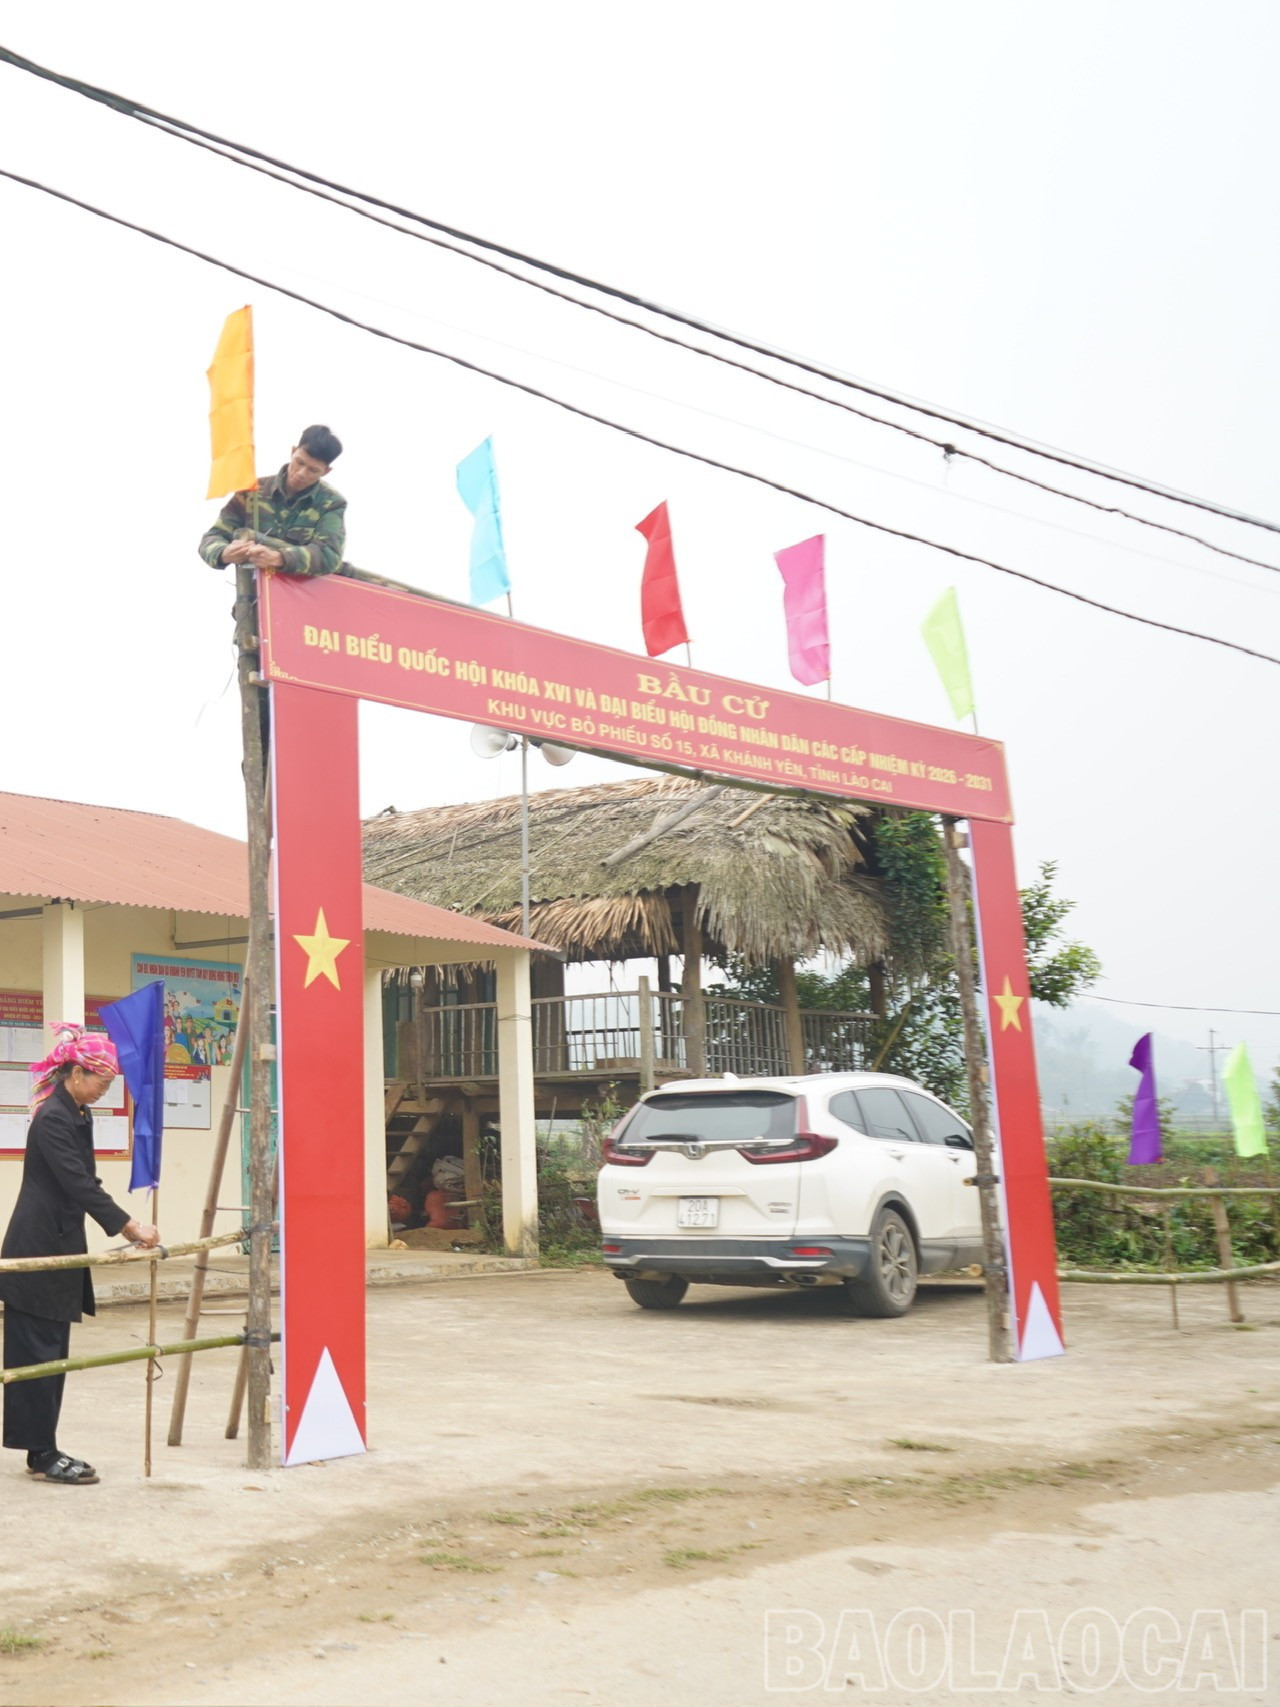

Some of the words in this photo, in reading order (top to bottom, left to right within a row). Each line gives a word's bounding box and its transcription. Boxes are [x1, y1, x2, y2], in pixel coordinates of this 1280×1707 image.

[304, 625, 340, 654] ĐẠI
[346, 633, 393, 664] BIỂU
[398, 647, 450, 677] QUỐC
[454, 660, 487, 687] HỘI
[491, 668, 540, 696] KHÓA
[544, 680, 571, 704] XVI
[575, 687, 597, 711] VÀ
[600, 694, 628, 719] ĐẠI
[631, 699, 666, 725] BIỂU
[670, 709, 695, 734] HỘI
[740, 725, 780, 749] NHÂN
[782, 733, 809, 755] DÂN
[811, 739, 839, 761] CÁC
[841, 744, 867, 766] CẤP
[869, 752, 909, 776] NHIỆM
[927, 765, 958, 784] 2026
[965, 774, 993, 792] 2031
[637, 671, 711, 706] BẦU
[721, 694, 770, 719] CỬ
[488, 698, 527, 720] KHU
[530, 708, 567, 729] VỰC
[570, 715, 596, 735] BỎ
[599, 724, 648, 746] PHIẾU
[650, 732, 673, 750] SỐ
[676, 740, 697, 758] 15,
[699, 743, 720, 760] XÃ
[723, 749, 773, 771] KHÁNH
[842, 772, 870, 789] LÀO
[872, 778, 894, 793] CAI
[688, 1200, 708, 1212] 20A
